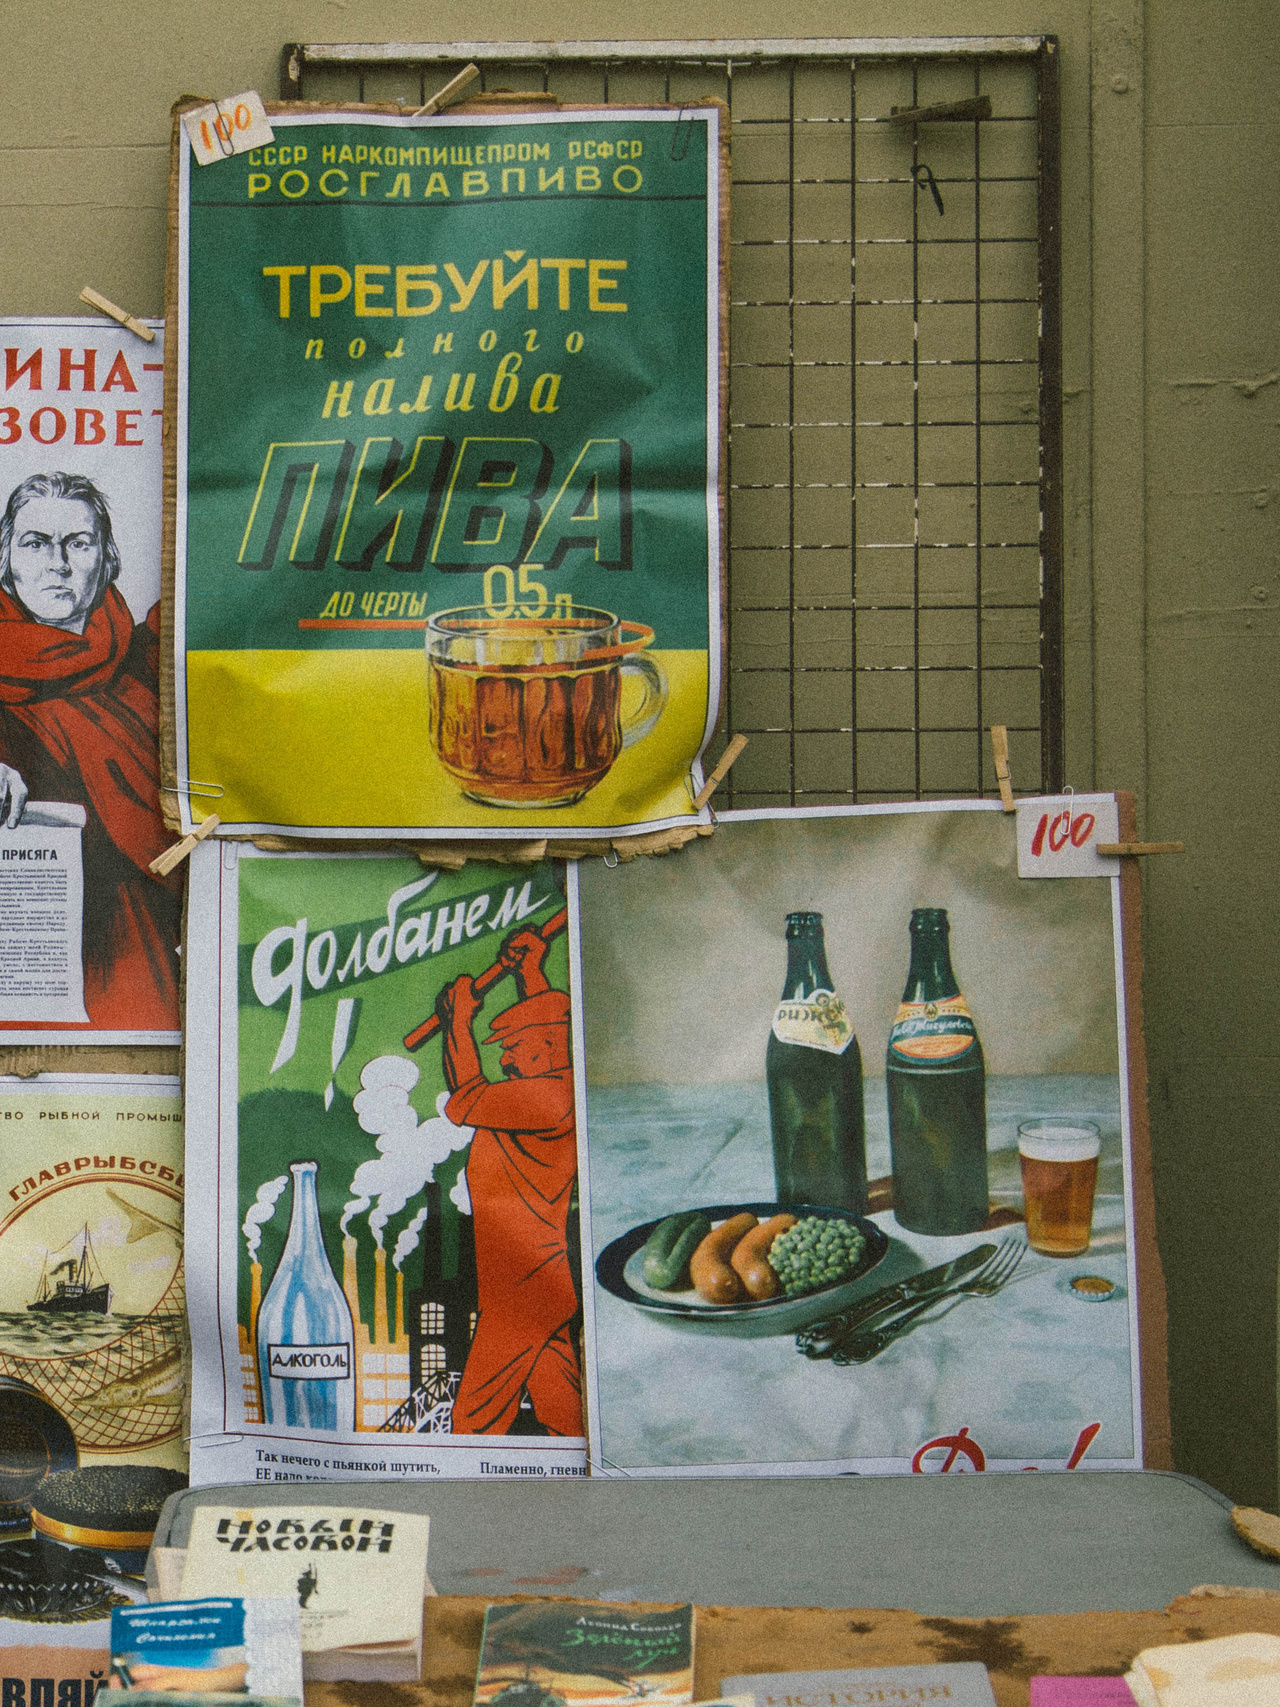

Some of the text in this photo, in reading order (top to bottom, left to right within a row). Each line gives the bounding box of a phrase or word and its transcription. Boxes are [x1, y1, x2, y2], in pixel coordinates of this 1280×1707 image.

[199, 104, 252, 151] 100
[248, 140, 643, 166] СССР НАРКОМПИЩЕПРОМ РСФСР
[247, 165, 644, 198] РОСГЛАВПИВО
[262, 249, 628, 319] ТРЕБУЙТЕ
[304, 328, 585, 360] полного
[322, 351, 563, 419] налива
[236, 436, 634, 573] ПИВА
[320, 592, 355, 618] ДО
[361, 592, 428, 617] ЧЕРТЫ
[1031, 812, 1096, 857] 100
[2, 849, 58, 861] ПРИСЯГА
[39, 1111, 100, 1121] РЫБНОЙ
[272, 1351, 347, 1368] АЛКОГОЛЬ
[255, 1468, 271, 1480] ЕЕ
[256, 1450, 441, 1476] Так нечего с пьянкой шутить,
[480, 1462, 547, 1477] Пламенно,
